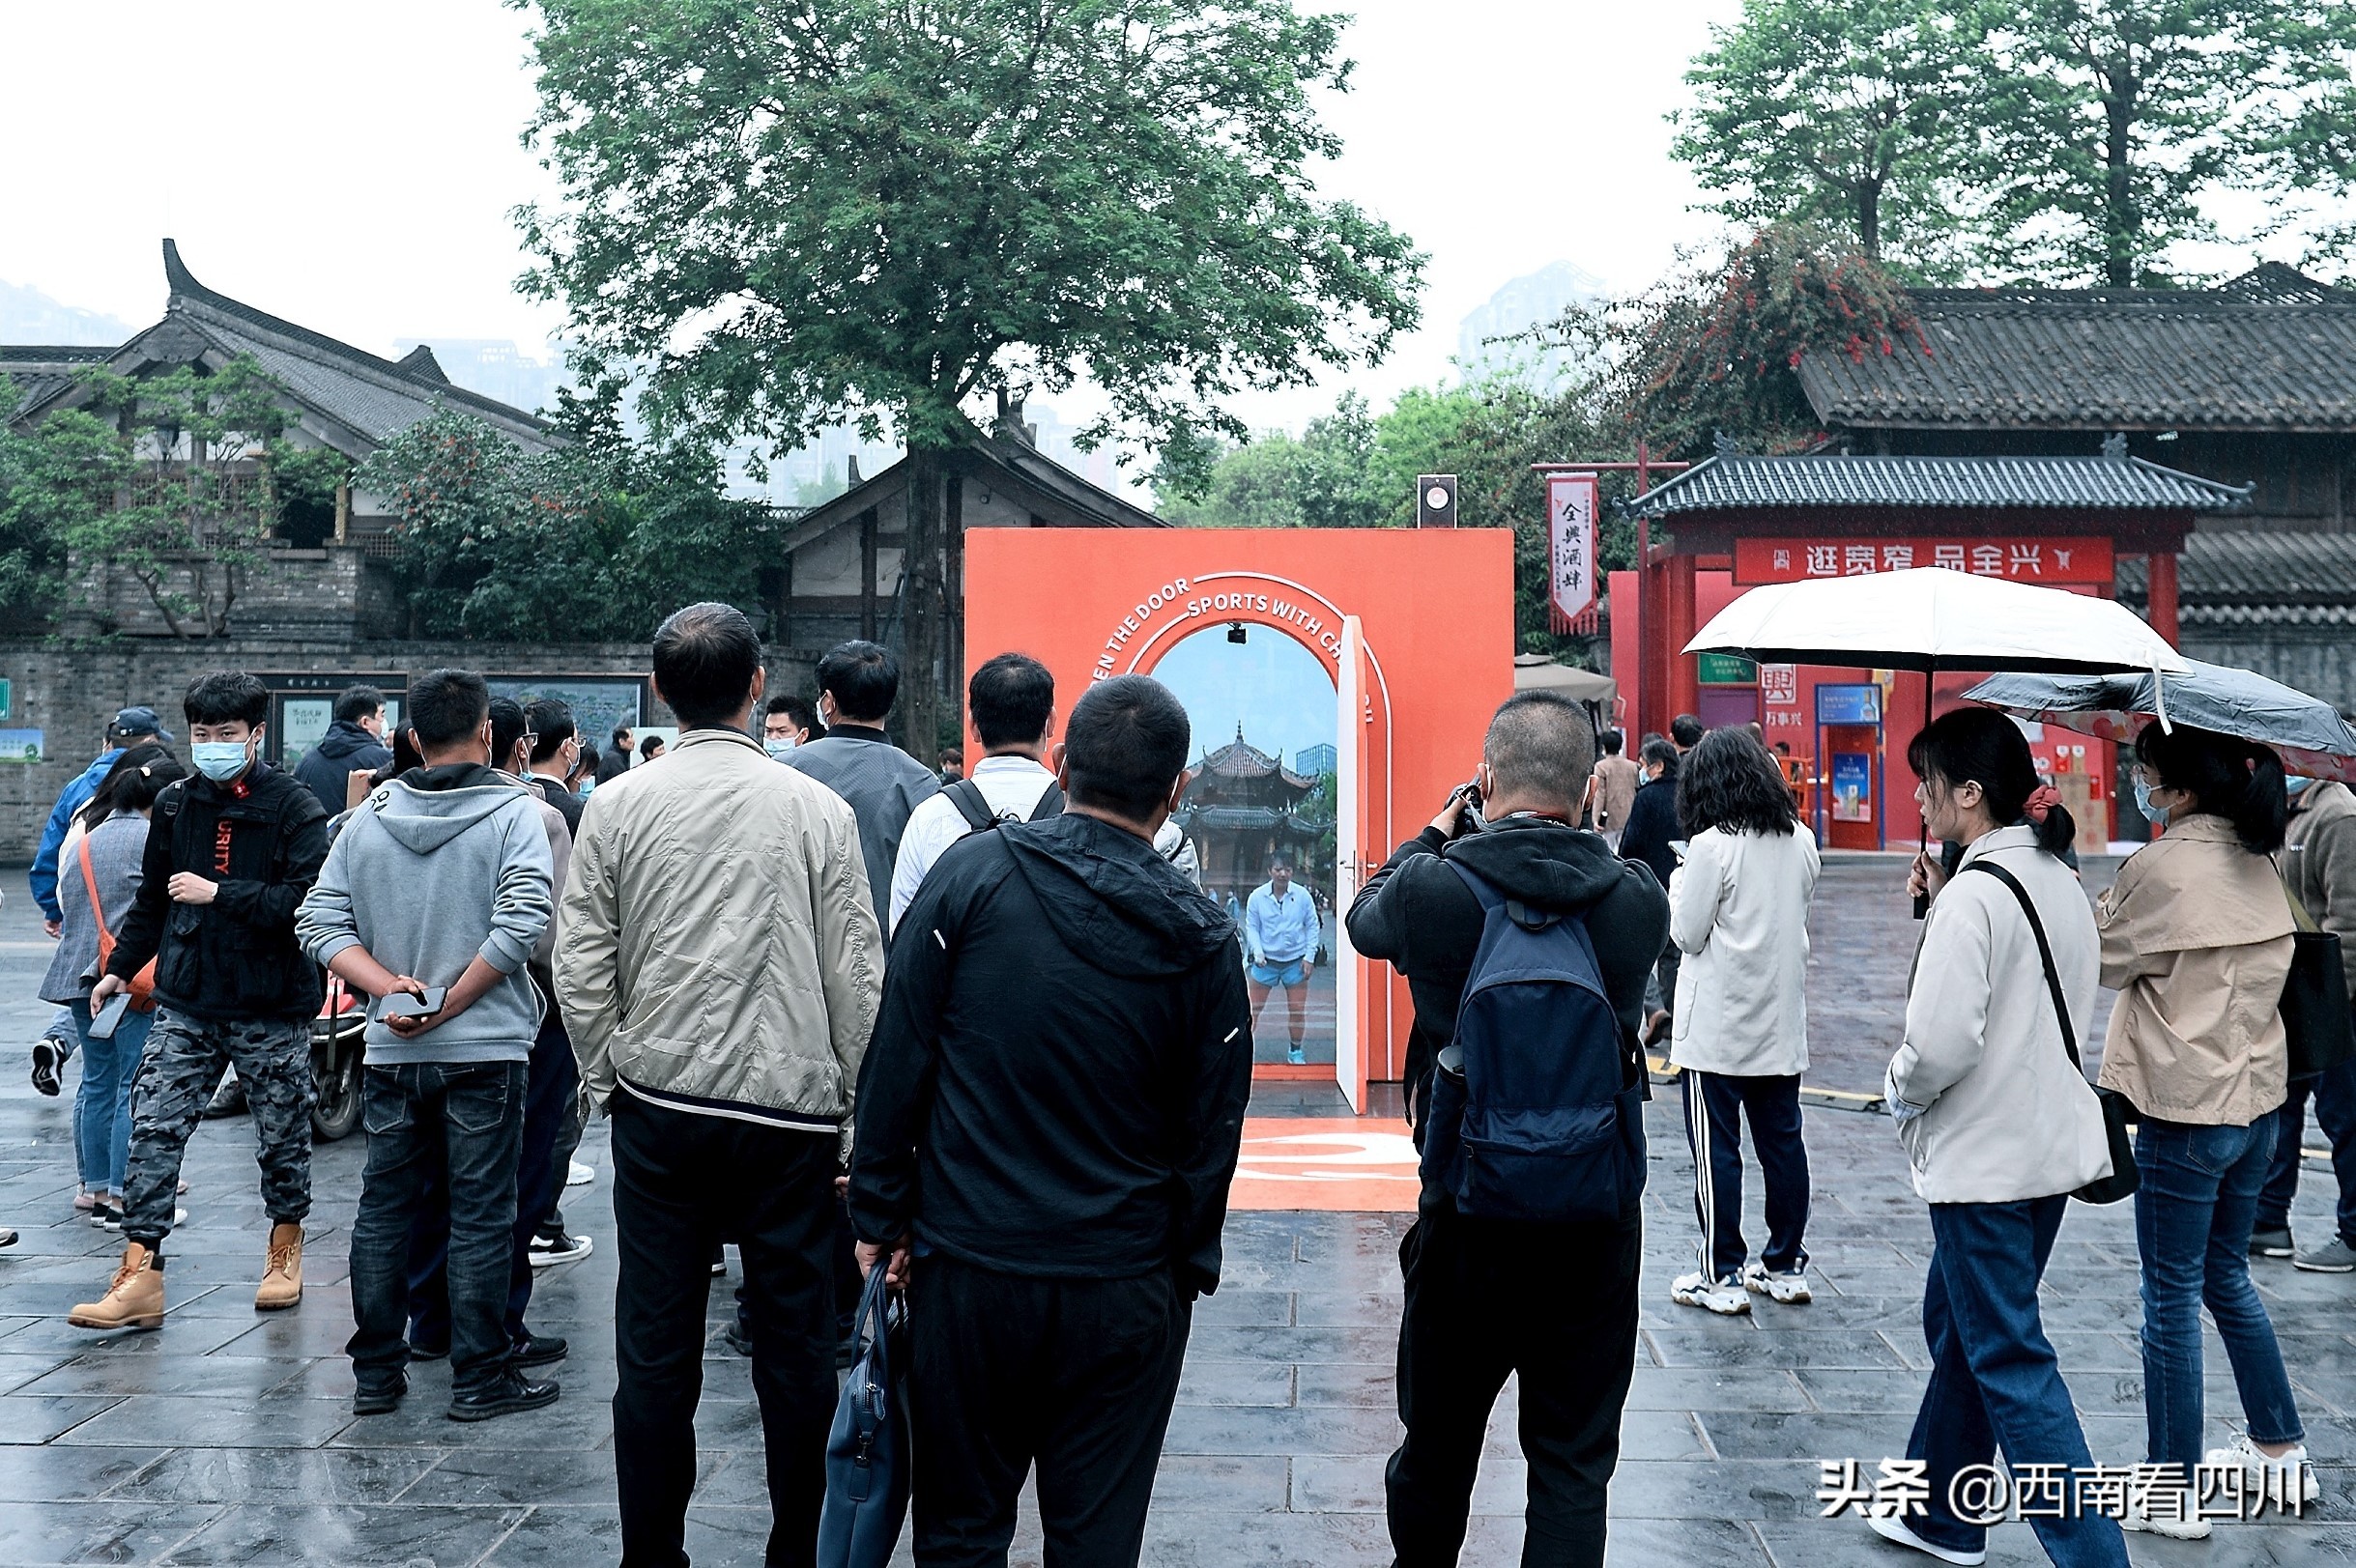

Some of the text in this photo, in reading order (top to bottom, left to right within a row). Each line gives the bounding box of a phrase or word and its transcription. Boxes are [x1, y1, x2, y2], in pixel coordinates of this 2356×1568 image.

[1805, 545, 1914, 576] 逛宽窄
[1935, 544, 2042, 576] 品全兴
[1090, 577, 1192, 688] EN THE DOOR
[1187, 592, 1341, 664] SPORTS WITH CH
